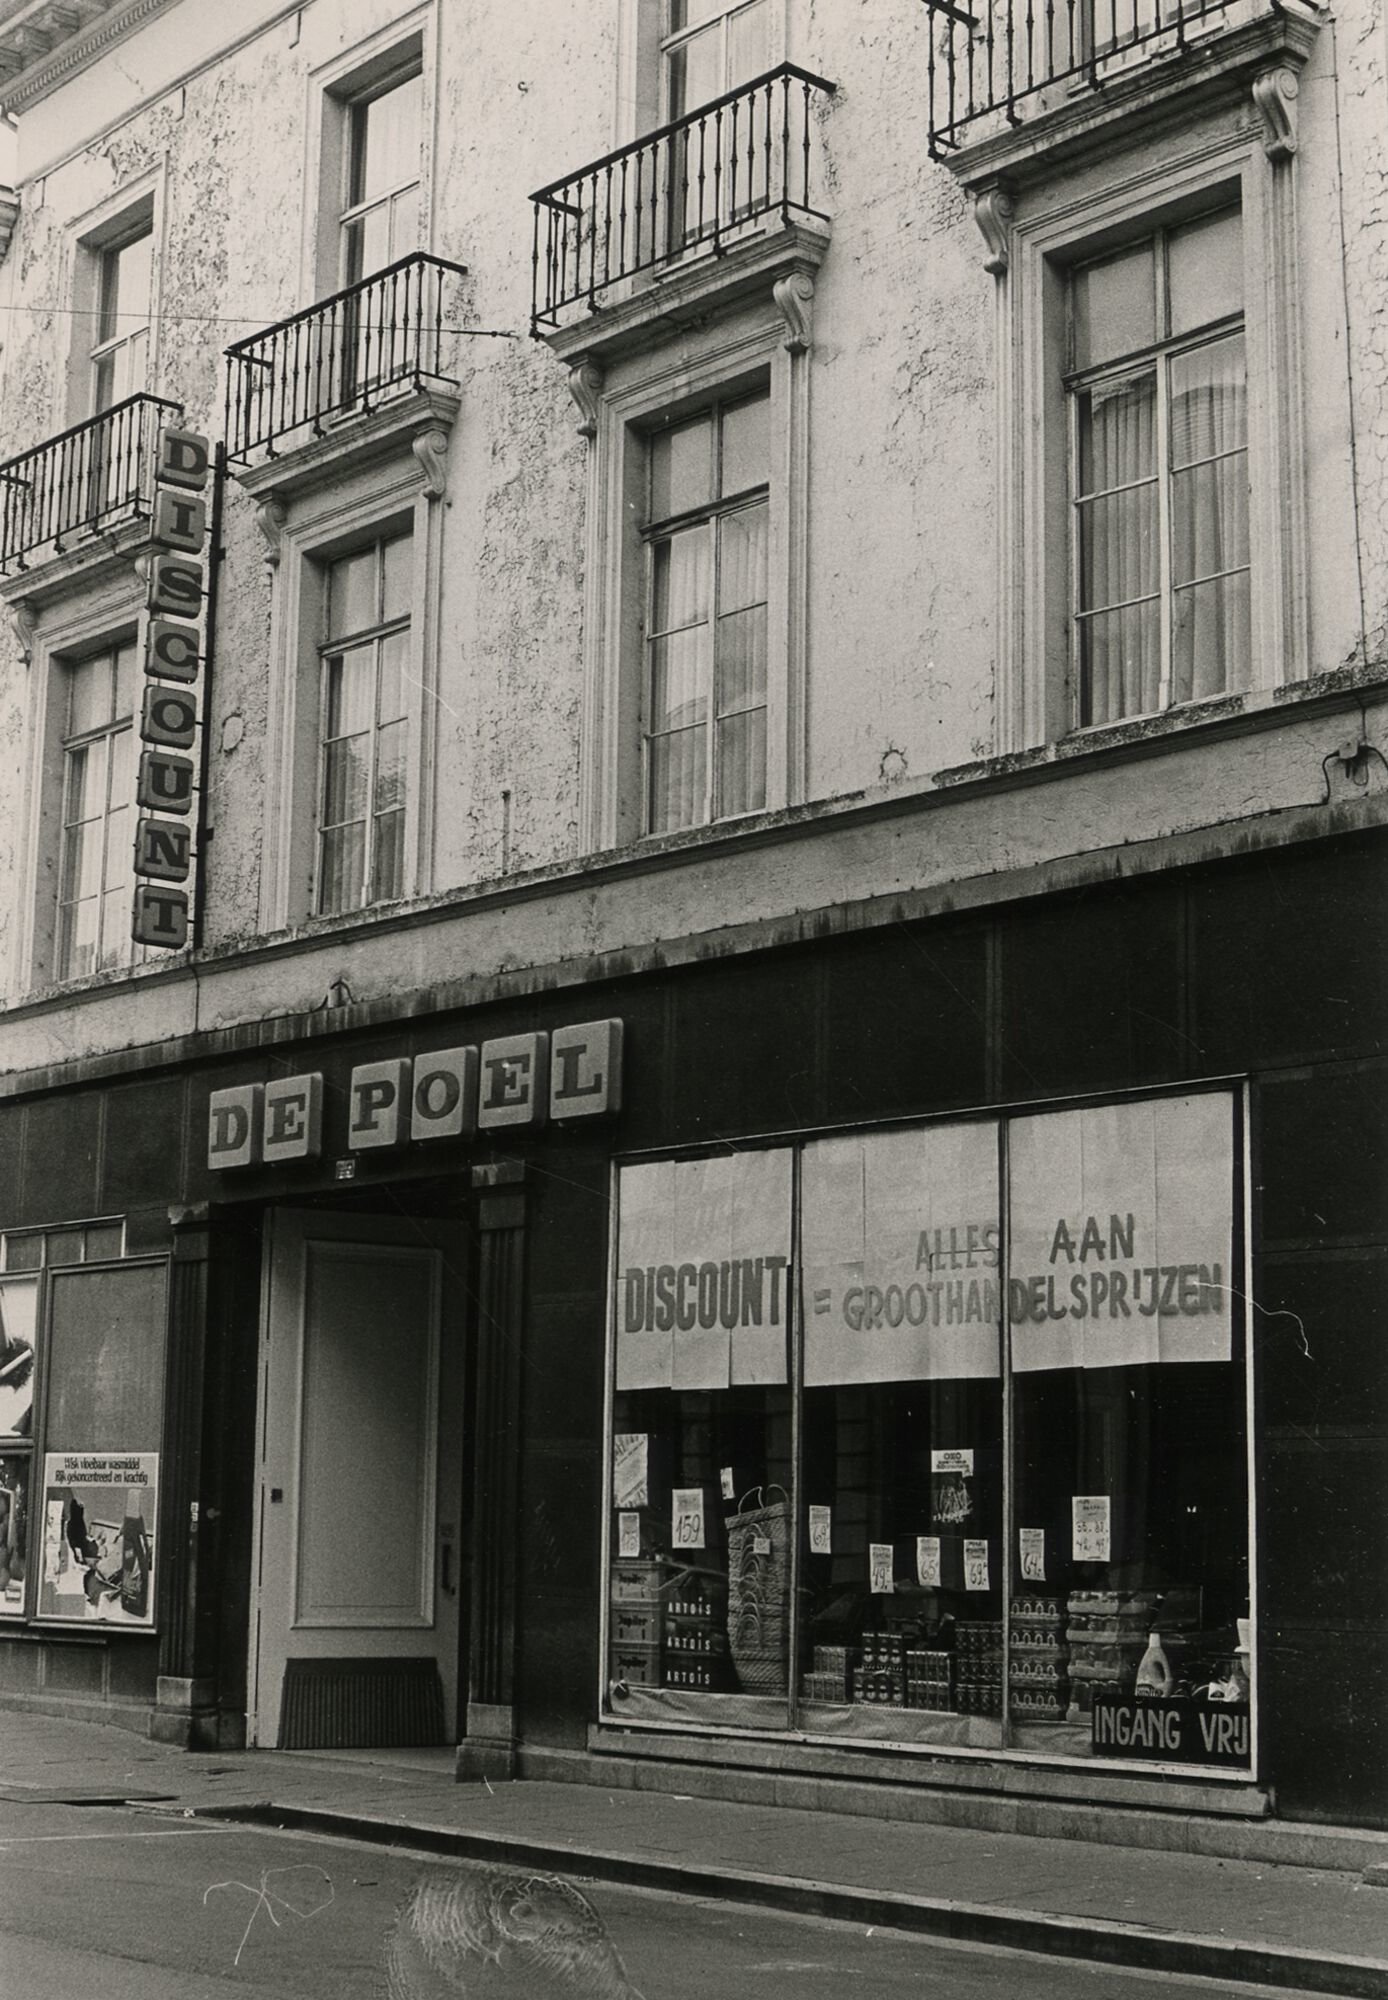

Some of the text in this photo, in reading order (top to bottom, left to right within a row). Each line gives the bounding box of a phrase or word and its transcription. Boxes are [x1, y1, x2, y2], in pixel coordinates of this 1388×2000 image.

[142, 434, 206, 934] DISCOUNT
[210, 1044, 603, 1154] DE POEL
[915, 1213, 1136, 1271] ALLES AAN
[623, 1255, 789, 1334] DISCOUNT
[842, 1262, 1224, 1332] GROOTHANDELSPRIJZEN
[676, 1514, 701, 1543] 159
[1095, 1704, 1248, 1755] INGANG VRIJ
